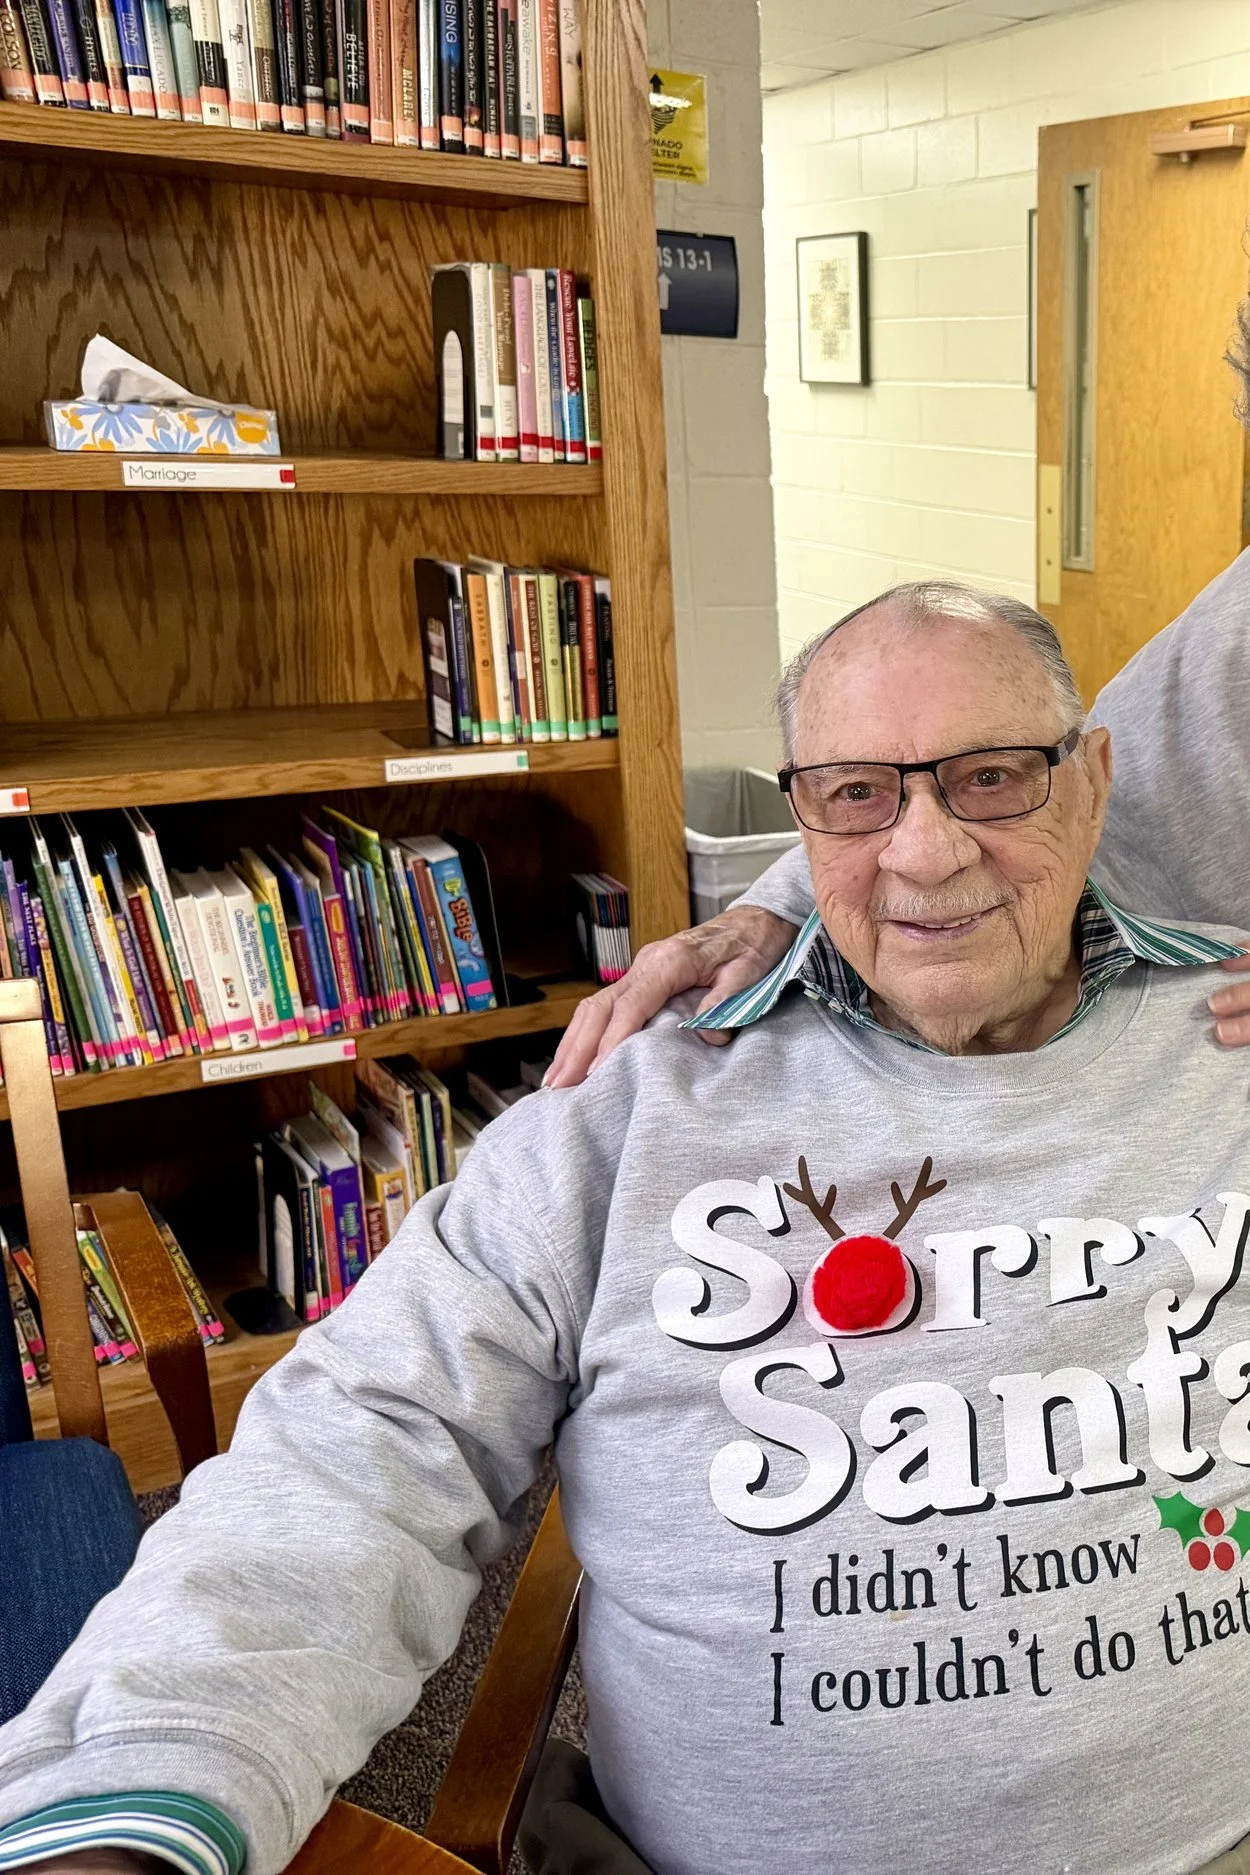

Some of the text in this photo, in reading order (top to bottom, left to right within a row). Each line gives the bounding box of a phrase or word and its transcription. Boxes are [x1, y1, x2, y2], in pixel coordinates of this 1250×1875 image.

[487, 15, 496, 67] BARBARIAN
[563, 7, 579, 41] WAY
[85, 36, 98, 72] HYBELS
[346, 33, 359, 91] BELIEVE
[488, 69, 496, 89] WAY
[677, 248, 712, 272] 13-1
[535, 302, 546, 356] LANGUAGE
[129, 465, 197, 483] Marriage
[391, 761, 453, 777] Disciplines
[234, 908, 248, 943] Question
[242, 950, 255, 977] Answer
[245, 915, 269, 990] The Beginner's Bible
[248, 977, 260, 998] Book
[208, 1058, 263, 1076] Children
[770, 1534, 1140, 1633] I didn't know
[770, 1652, 785, 1725] I
[810, 1629, 1052, 1713] couldn't
[1073, 1627, 1136, 1680] do
